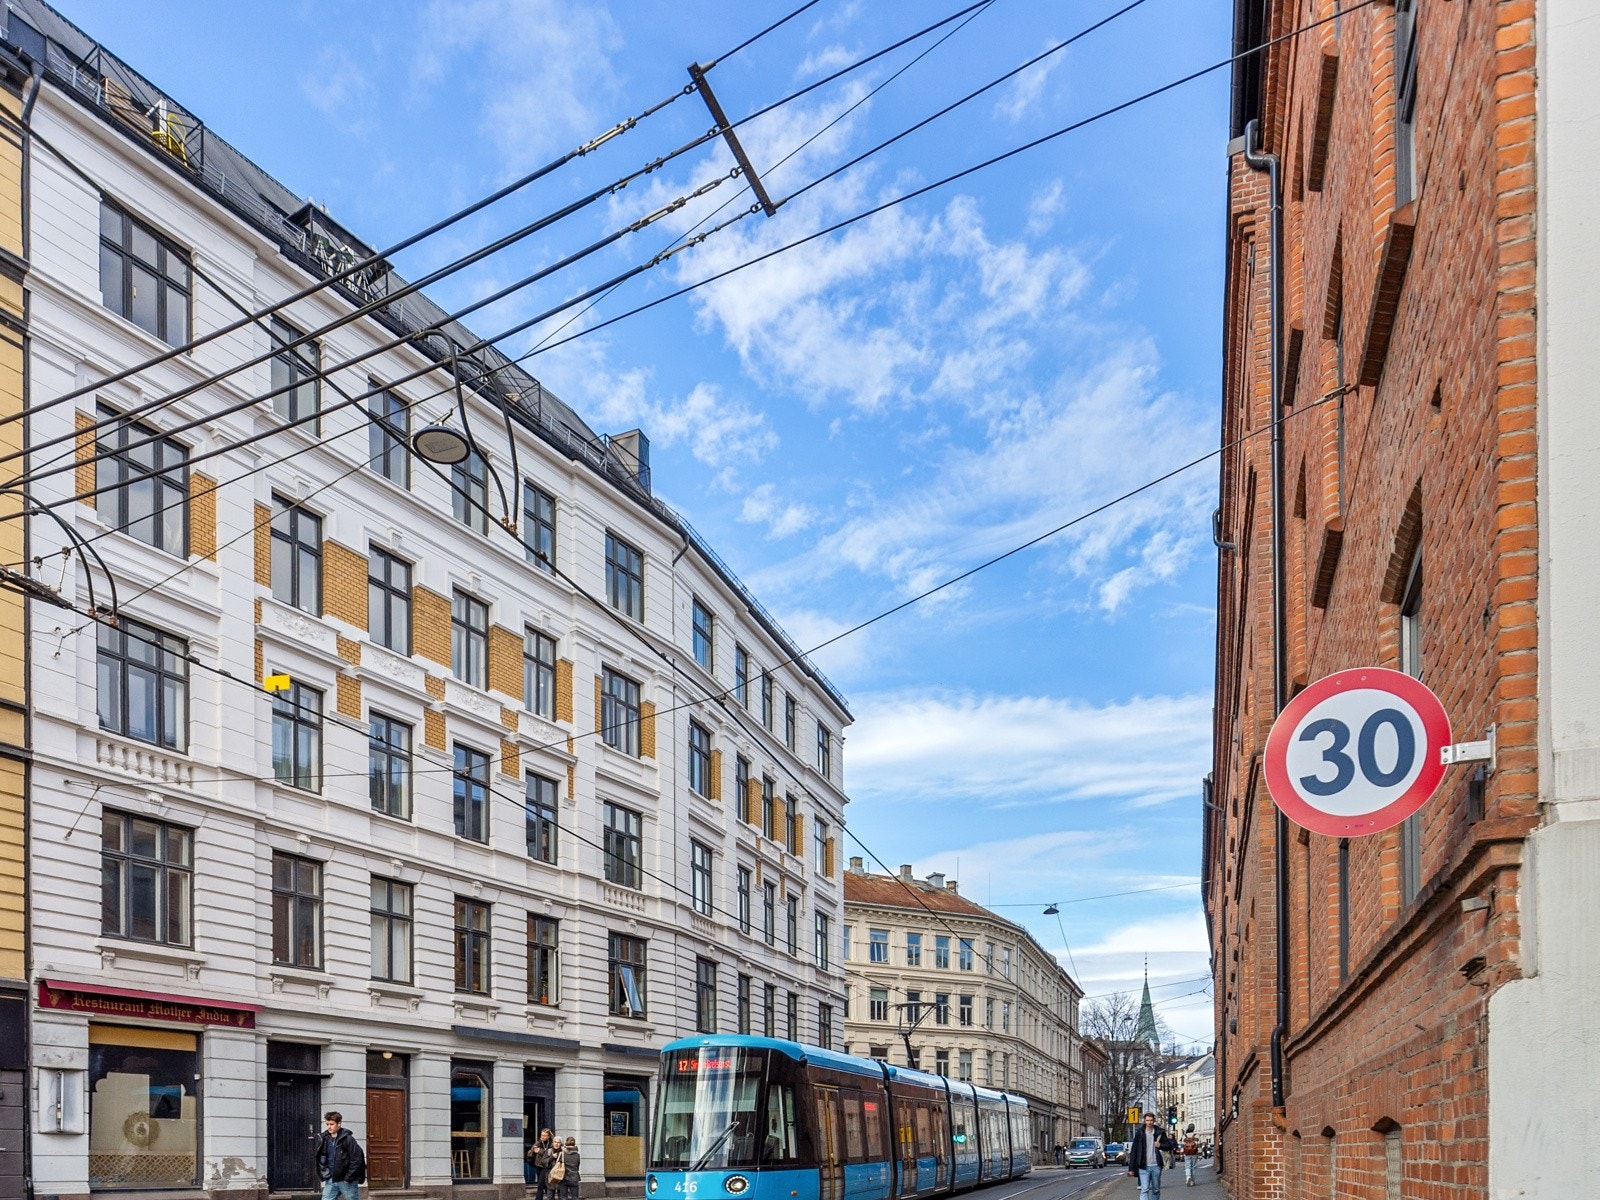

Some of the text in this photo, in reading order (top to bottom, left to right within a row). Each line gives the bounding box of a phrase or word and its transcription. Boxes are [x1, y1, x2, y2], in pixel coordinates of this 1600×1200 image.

[1298, 708, 1415, 796] 30
[72, 993, 230, 1023] Restaurant Mother India
[679, 1060, 688, 1070] 17
[675, 1181, 698, 1193] 416
